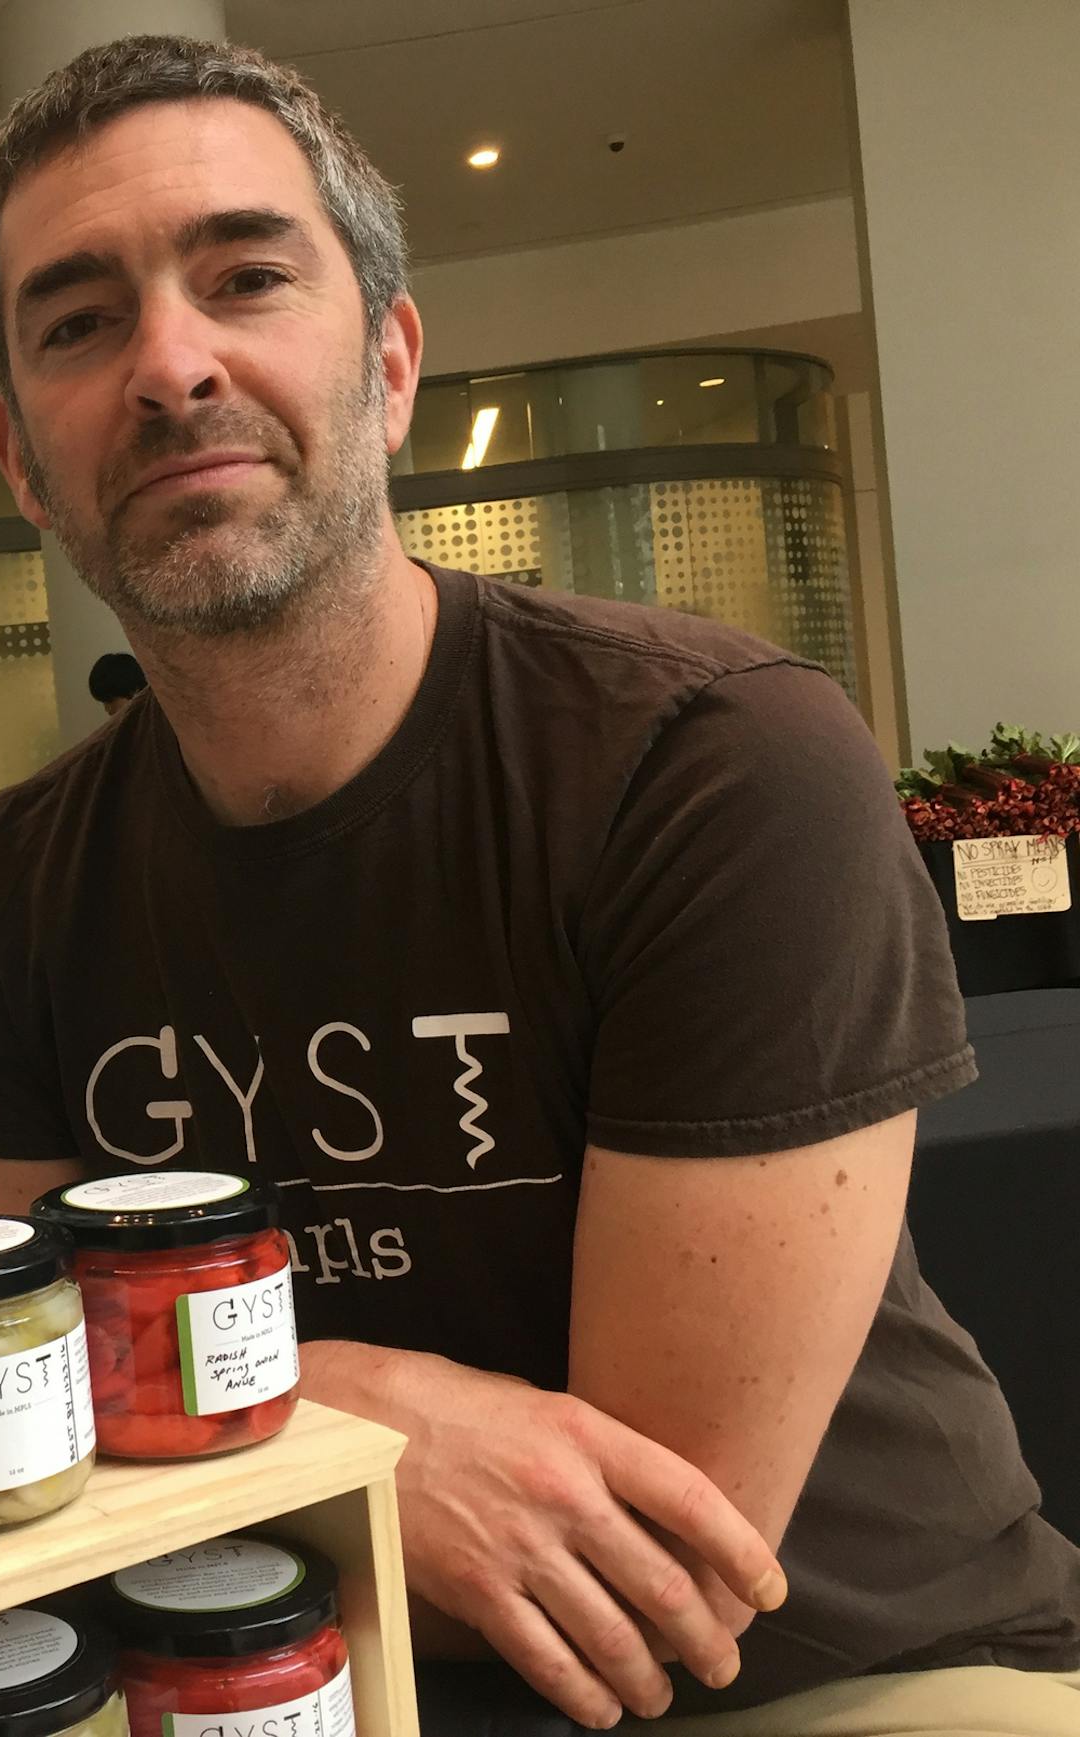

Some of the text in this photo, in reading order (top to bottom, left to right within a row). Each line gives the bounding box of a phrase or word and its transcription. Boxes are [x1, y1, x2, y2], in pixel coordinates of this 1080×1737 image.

[957, 843, 979, 861] NO
[981, 840, 1020, 860] SPRAY
[85, 1011, 510, 1170] GYST
[213, 1282, 283, 1331] GYST
[205, 1346, 247, 1367] RADISH
